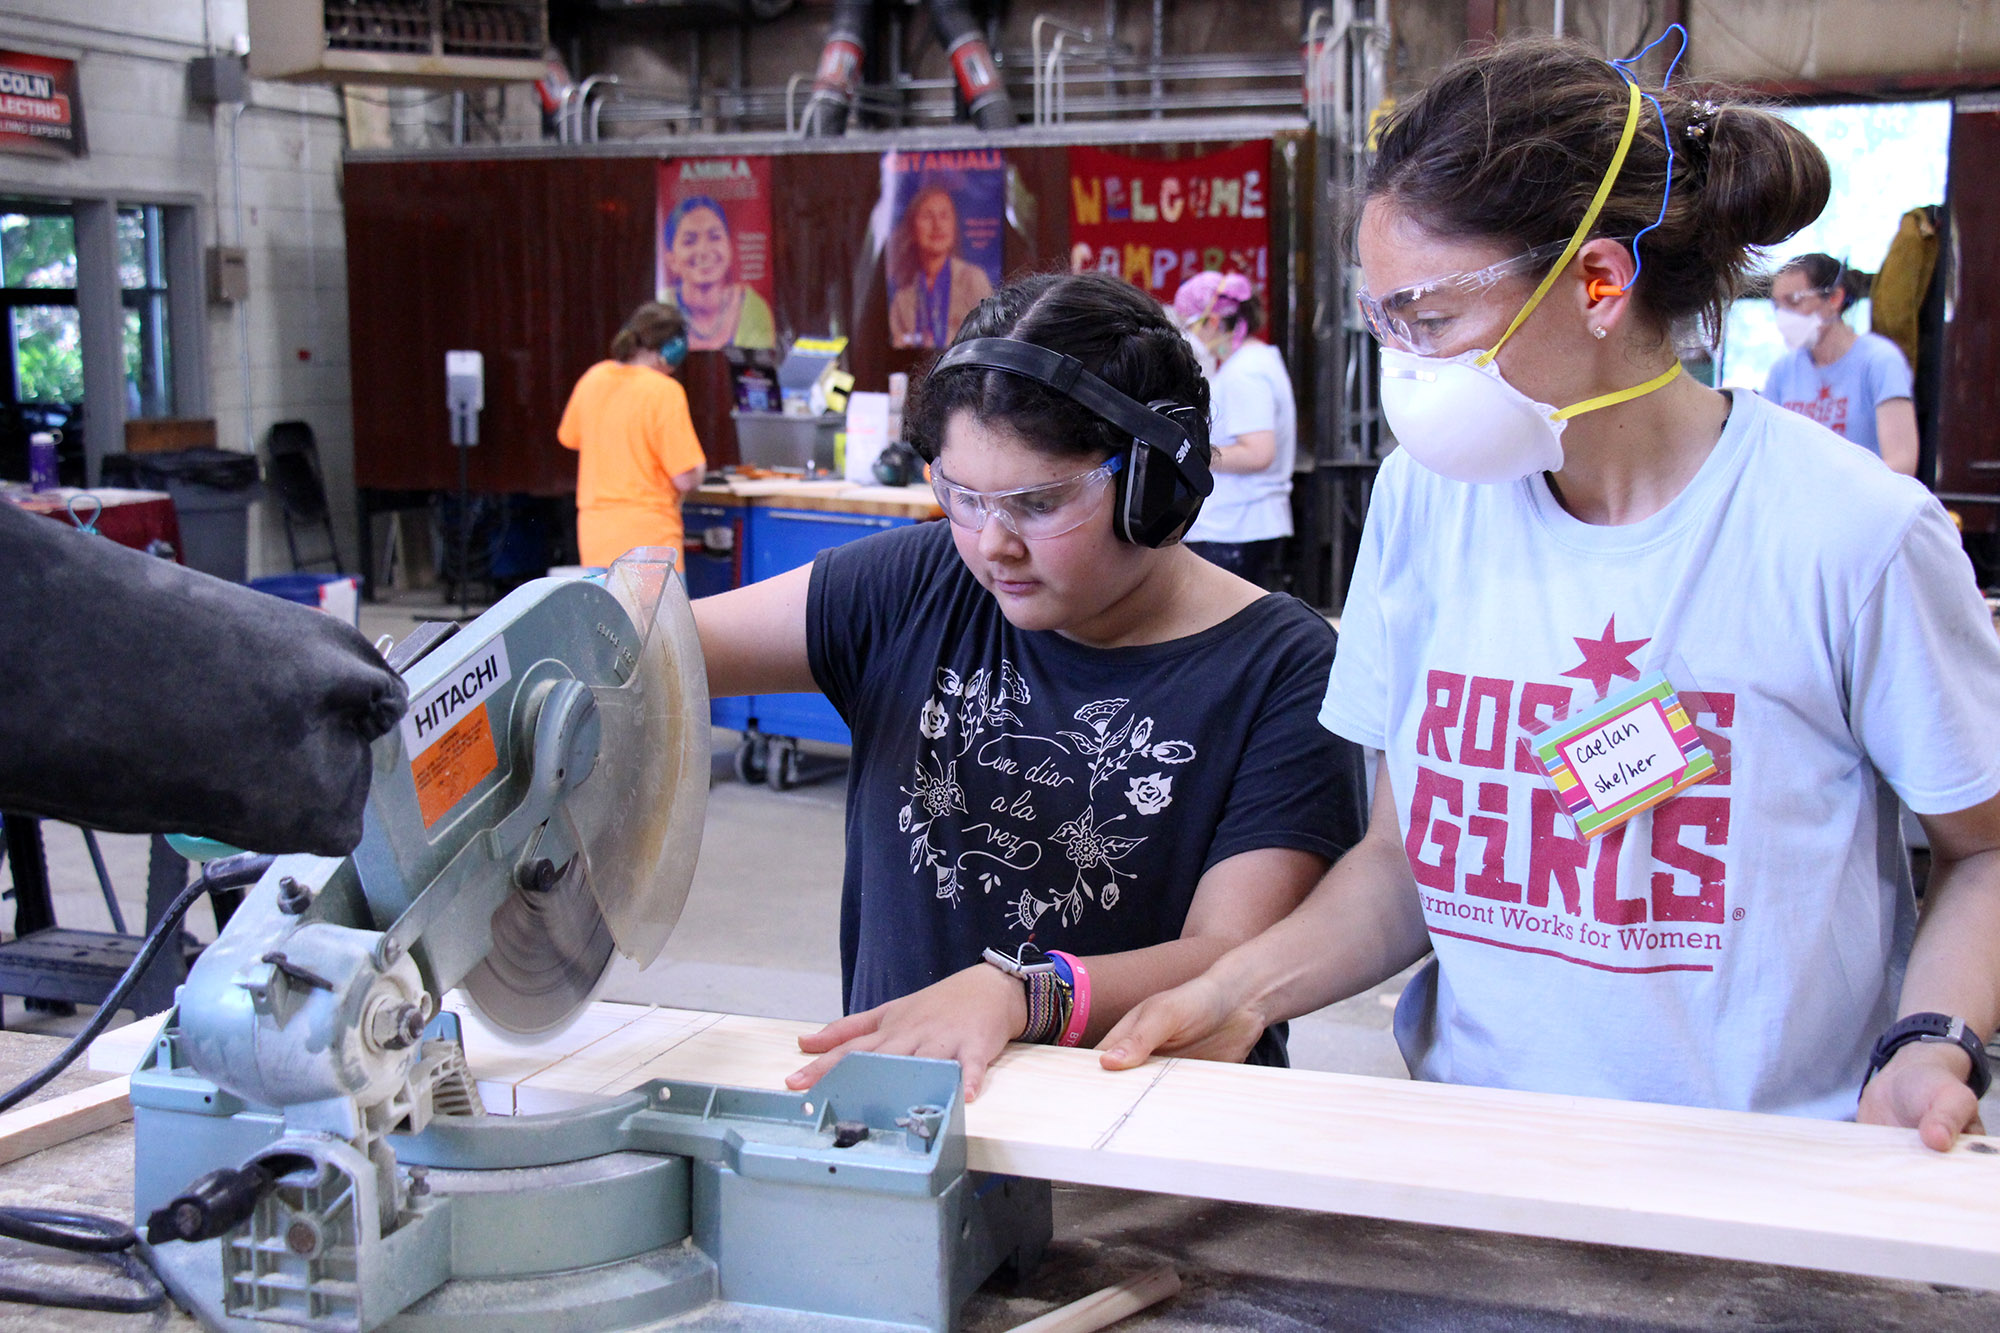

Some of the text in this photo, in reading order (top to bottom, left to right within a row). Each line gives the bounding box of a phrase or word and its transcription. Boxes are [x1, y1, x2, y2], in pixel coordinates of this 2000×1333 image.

[1071, 170, 1266, 225] WELCOME
[1176, 438, 1192, 464] 3M
[414, 654, 498, 739] HITACHI
[1416, 669, 1735, 786] ROSS
[1594, 752, 1657, 794] she/her
[1499, 905, 1575, 941] Works
[1579, 922, 1611, 949] for
[1617, 928, 1723, 951] Women
